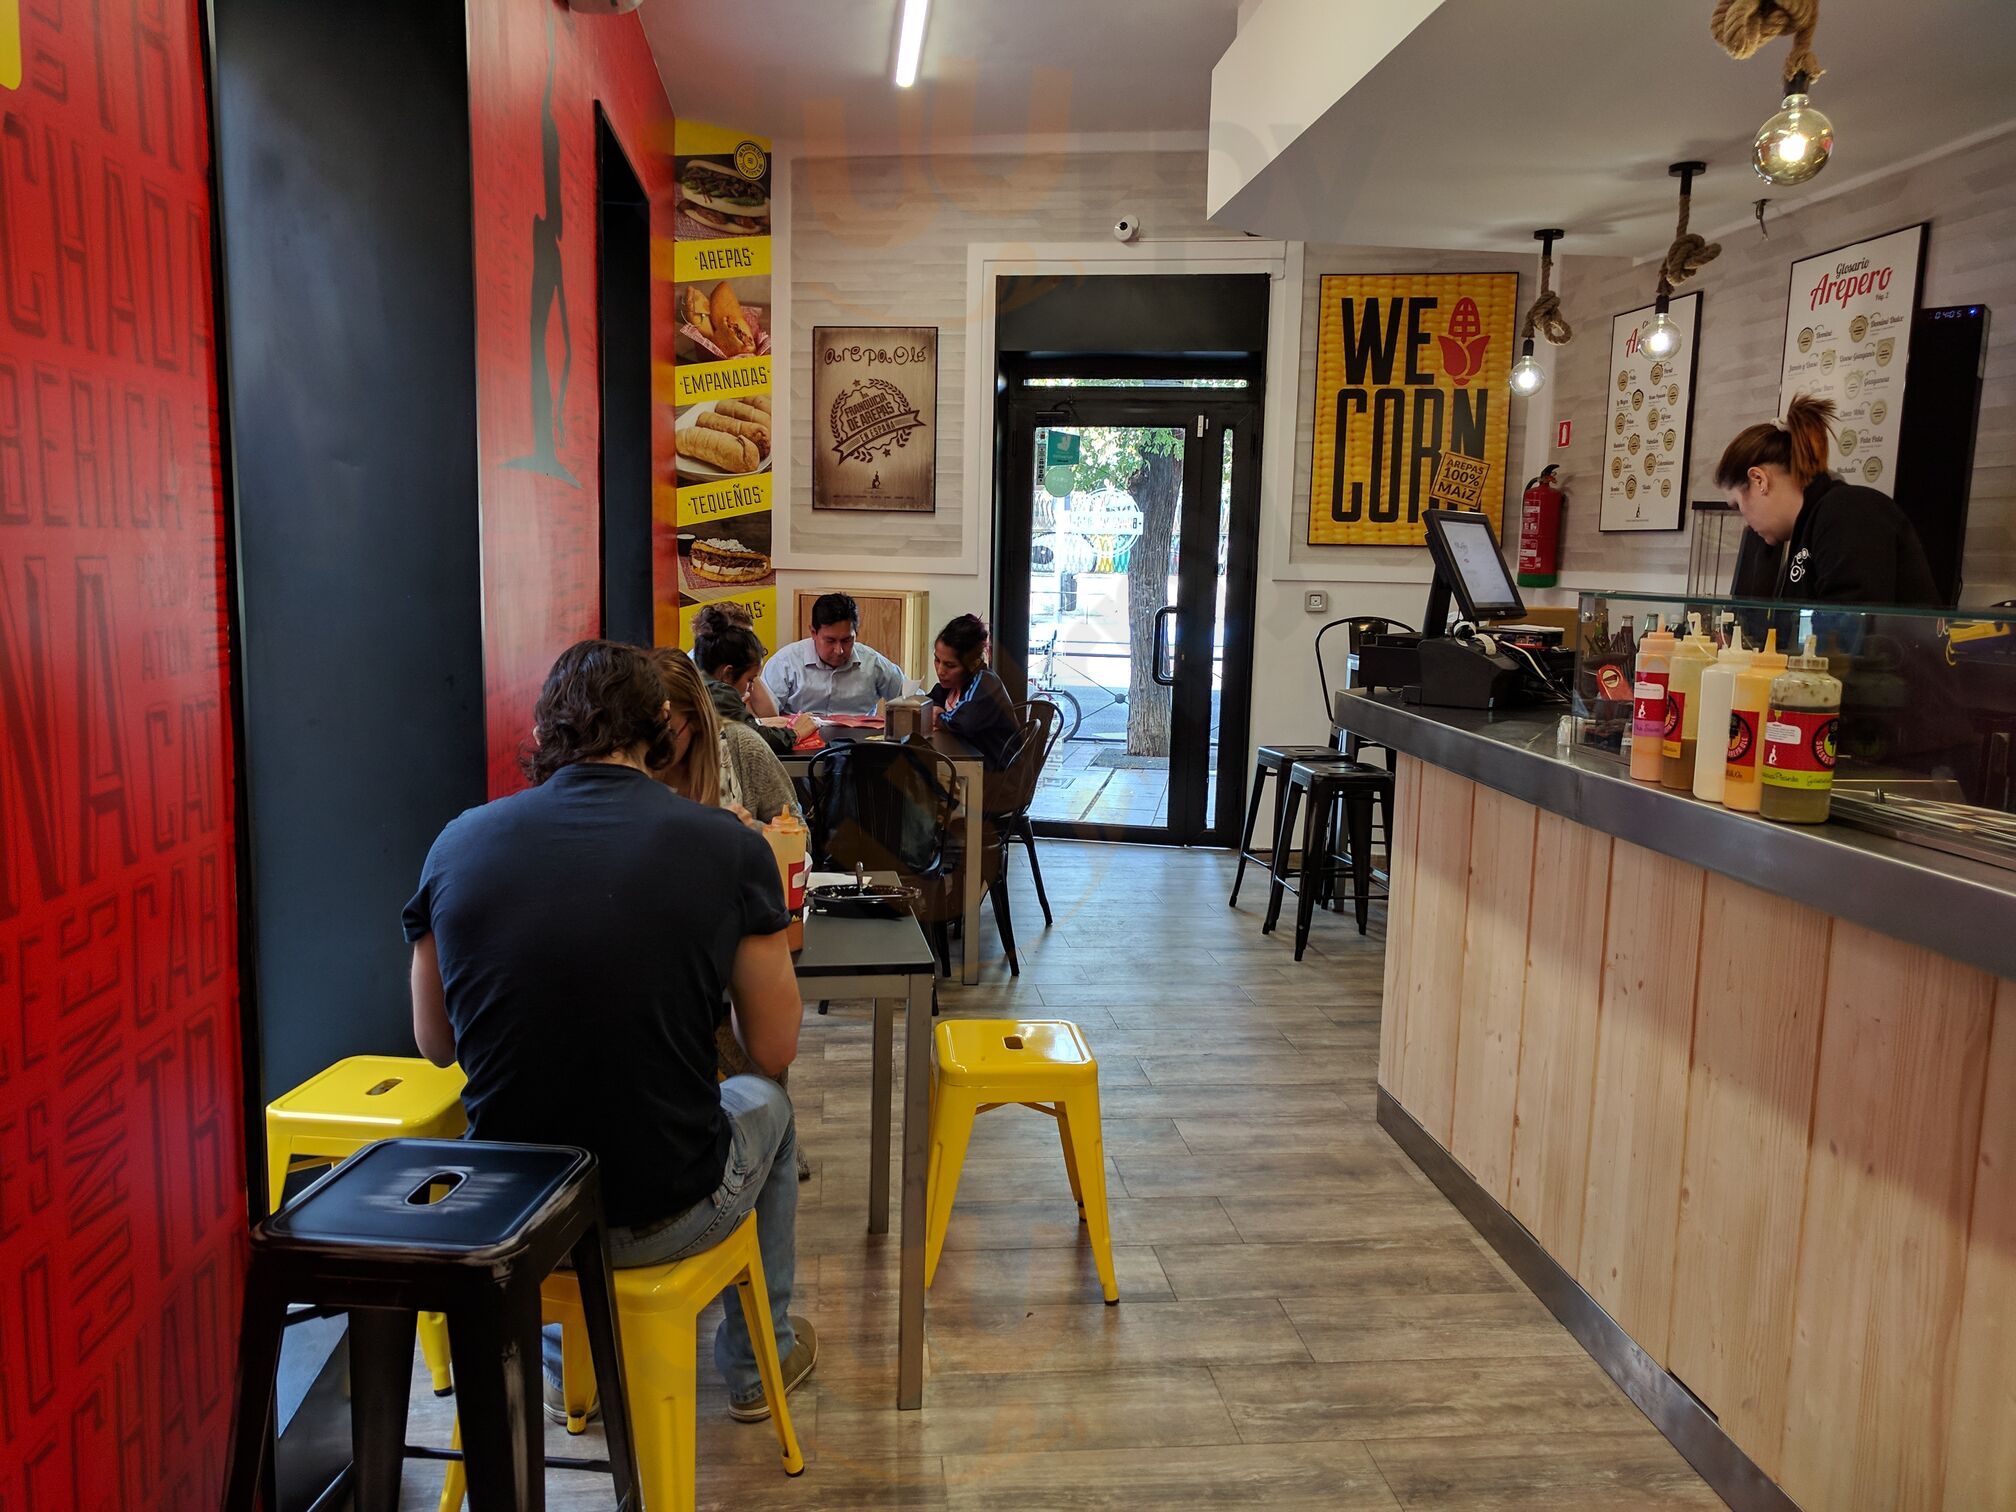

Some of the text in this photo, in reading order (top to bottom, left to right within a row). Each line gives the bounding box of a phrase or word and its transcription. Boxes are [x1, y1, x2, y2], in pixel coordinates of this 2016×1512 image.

[699, 248, 751, 270] AREPAS
[1836, 257, 1870, 279] Glosario
[1810, 267, 1894, 311] Arepero
[1934, 311, 1962, 320] 04:05
[1341, 297, 1438, 386] WE
[684, 366, 768, 395] EMPANADAS
[844, 392, 887, 418] FRANQUICIA
[847, 402, 895, 432] DE AREPAS
[860, 432, 870, 442] EN
[1331, 388, 1488, 524] CORN
[1447, 459, 1484, 474] AREPAS
[1443, 466, 1481, 487] 100%
[691, 484, 761, 516] TEQUEÑOS
